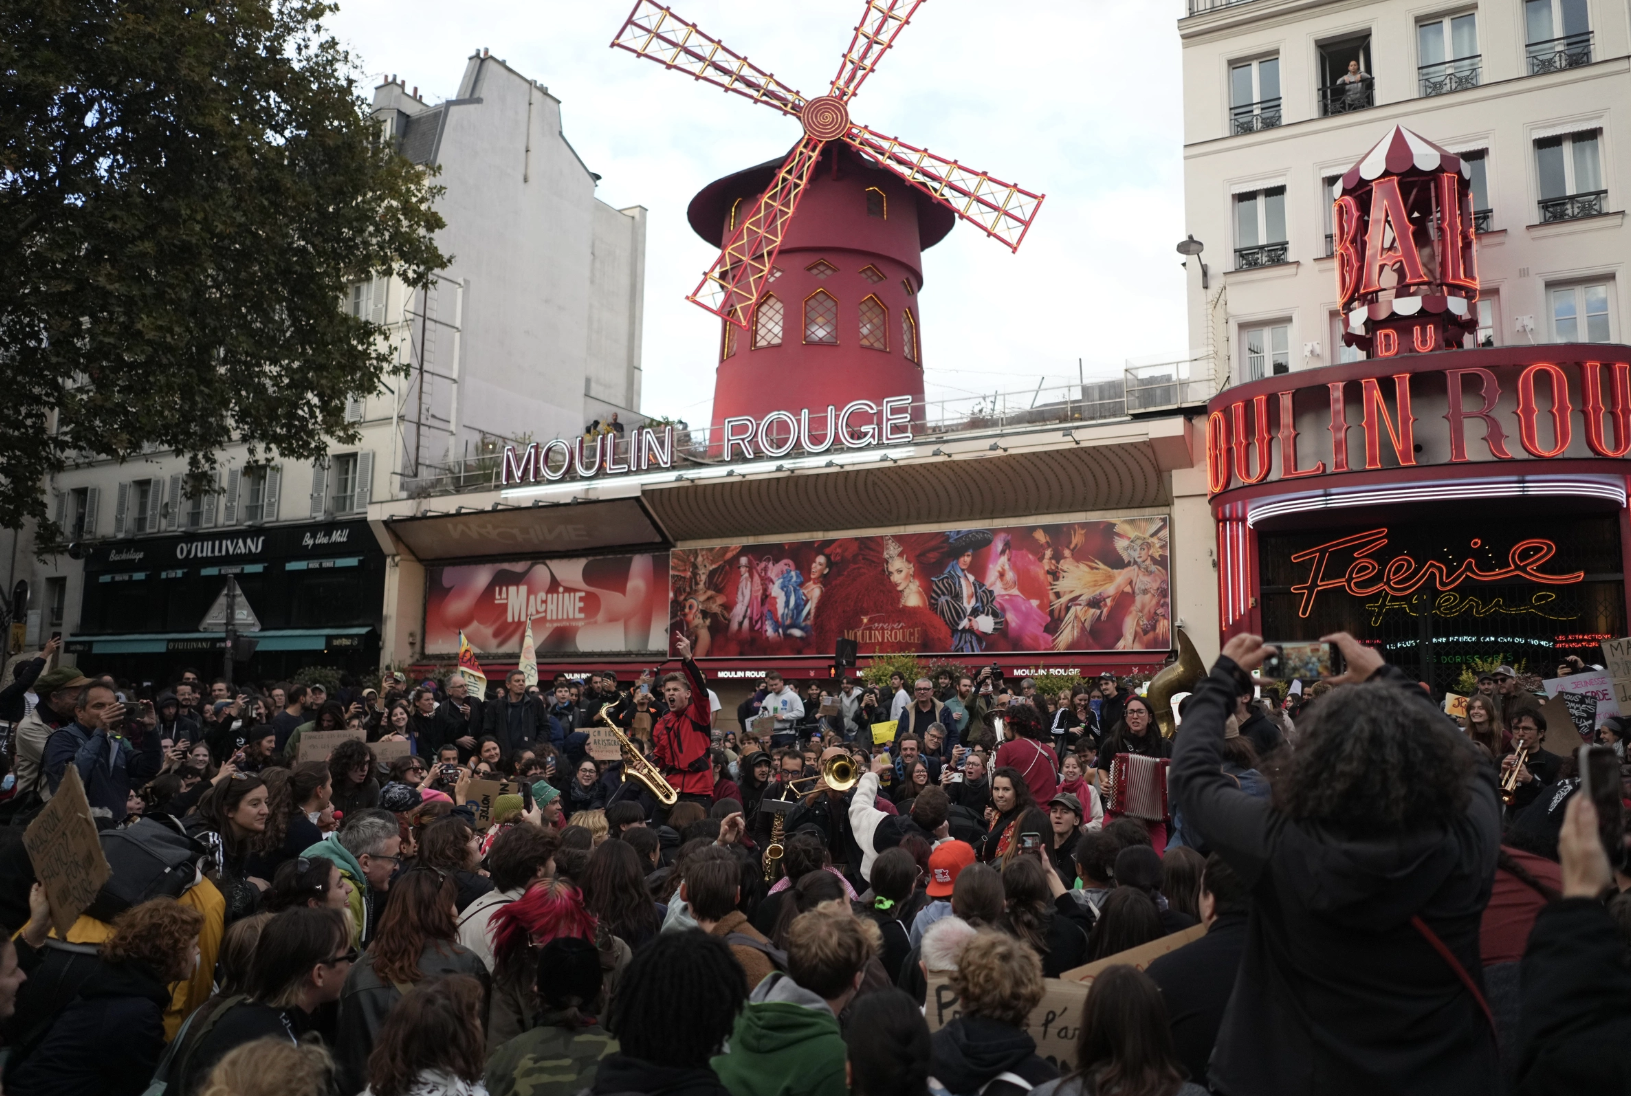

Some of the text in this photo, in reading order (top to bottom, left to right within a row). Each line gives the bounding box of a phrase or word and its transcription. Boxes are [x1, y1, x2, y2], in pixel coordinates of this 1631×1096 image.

[1334, 173, 1479, 308] BAL
[1377, 324, 1435, 357] DU
[502, 395, 914, 486] MOULIN ROUGE
[1206, 361, 1631, 497] OULIN ROU
[176, 536, 265, 560] O'SULLIVANS
[302, 528, 349, 549] By the Mill
[109, 548, 144, 562] Backstage
[495, 586, 507, 600] LA
[854, 613, 906, 631] Forever
[884, 627, 921, 643] ROUGE
[1440, 655, 1480, 664] DORISS
[1013, 668, 1081, 676] MOULIN ROUGE
[1571, 677, 1608, 690] JEUNESSE
[1565, 701, 1596, 713] OMMES
[479, 794, 490, 821] NOTRE
[28, 805, 61, 862] MACRON
[40, 831, 71, 888] FACHO?
[65, 852, 84, 884] FOR
[71, 879, 97, 911] SURE
